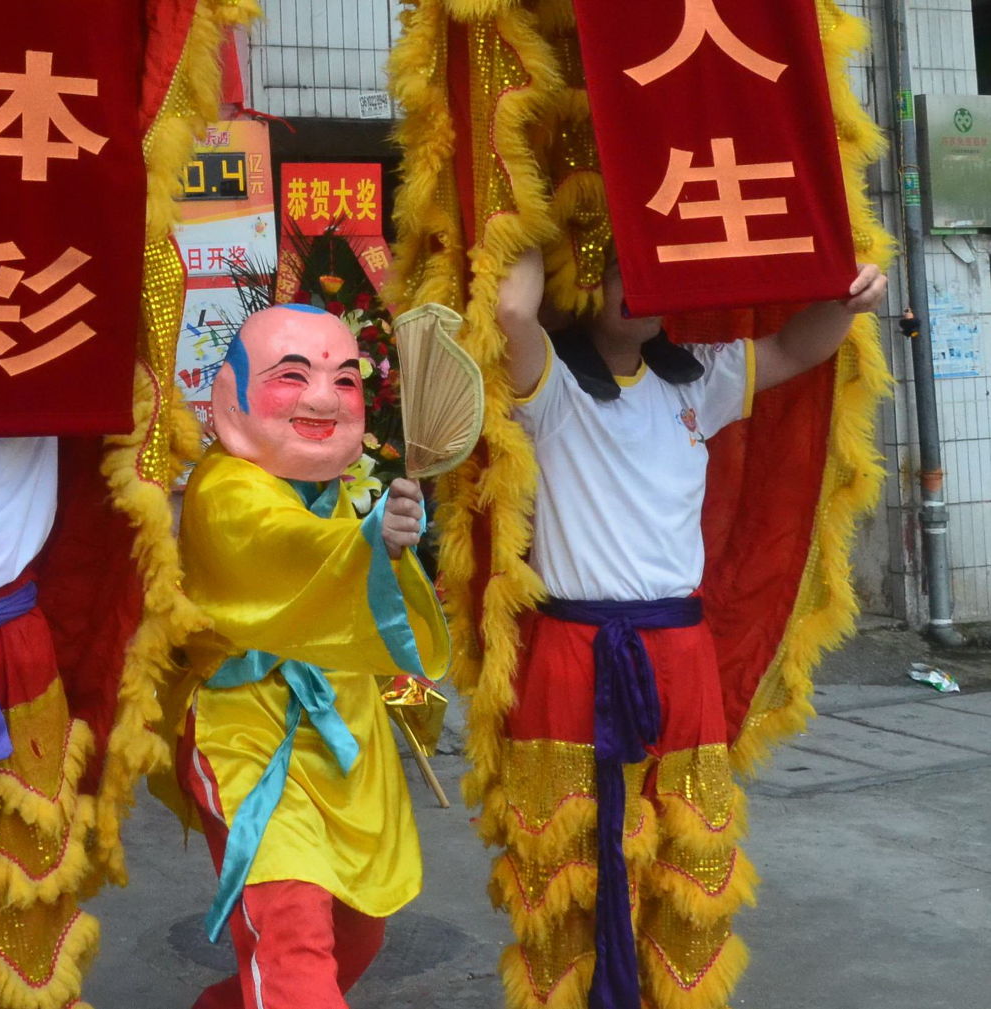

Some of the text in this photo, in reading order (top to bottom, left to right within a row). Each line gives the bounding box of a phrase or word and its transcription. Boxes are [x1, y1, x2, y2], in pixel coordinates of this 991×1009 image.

[248, 153, 265, 195] 亿元
[287, 177, 377, 221] 恭贺大奖
[187, 245, 248, 270] 日开奖
